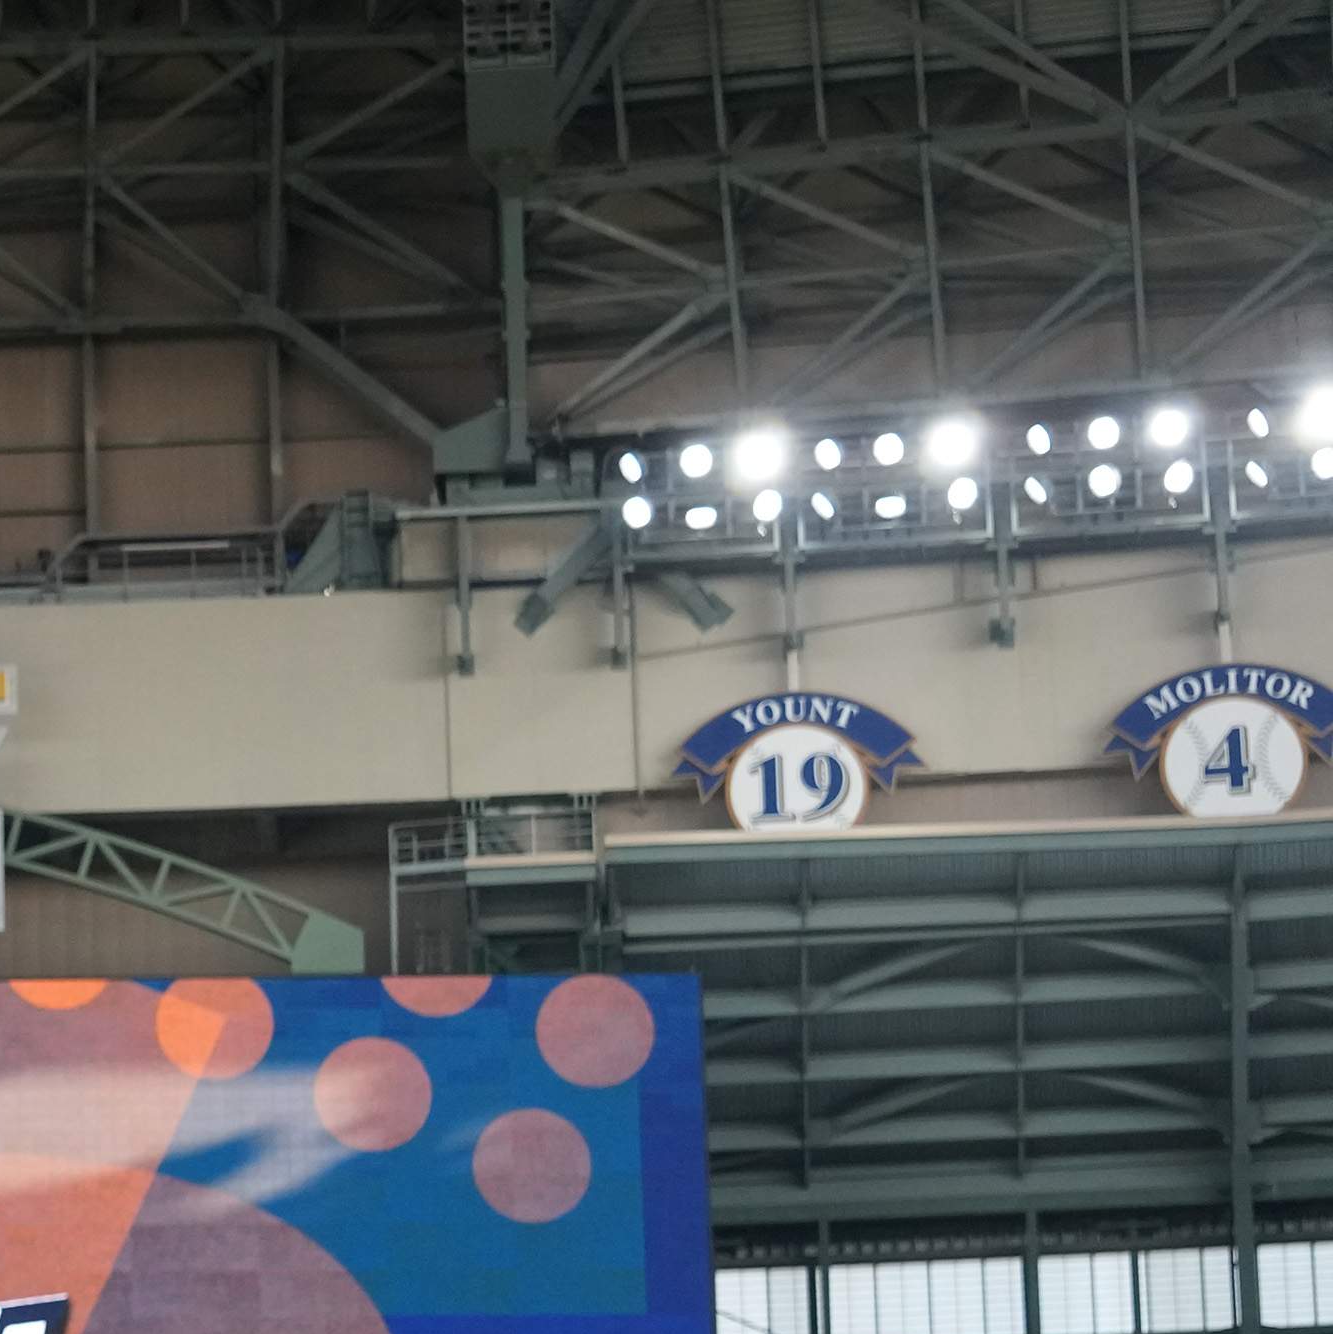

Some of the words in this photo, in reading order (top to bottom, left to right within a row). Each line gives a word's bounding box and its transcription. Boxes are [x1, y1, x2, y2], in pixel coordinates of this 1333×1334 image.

[733, 698, 861, 734] YOUNT
[1144, 666, 1315, 720] MOLITOR
[749, 752, 851, 822] 19
[1202, 725, 1255, 796] 4
